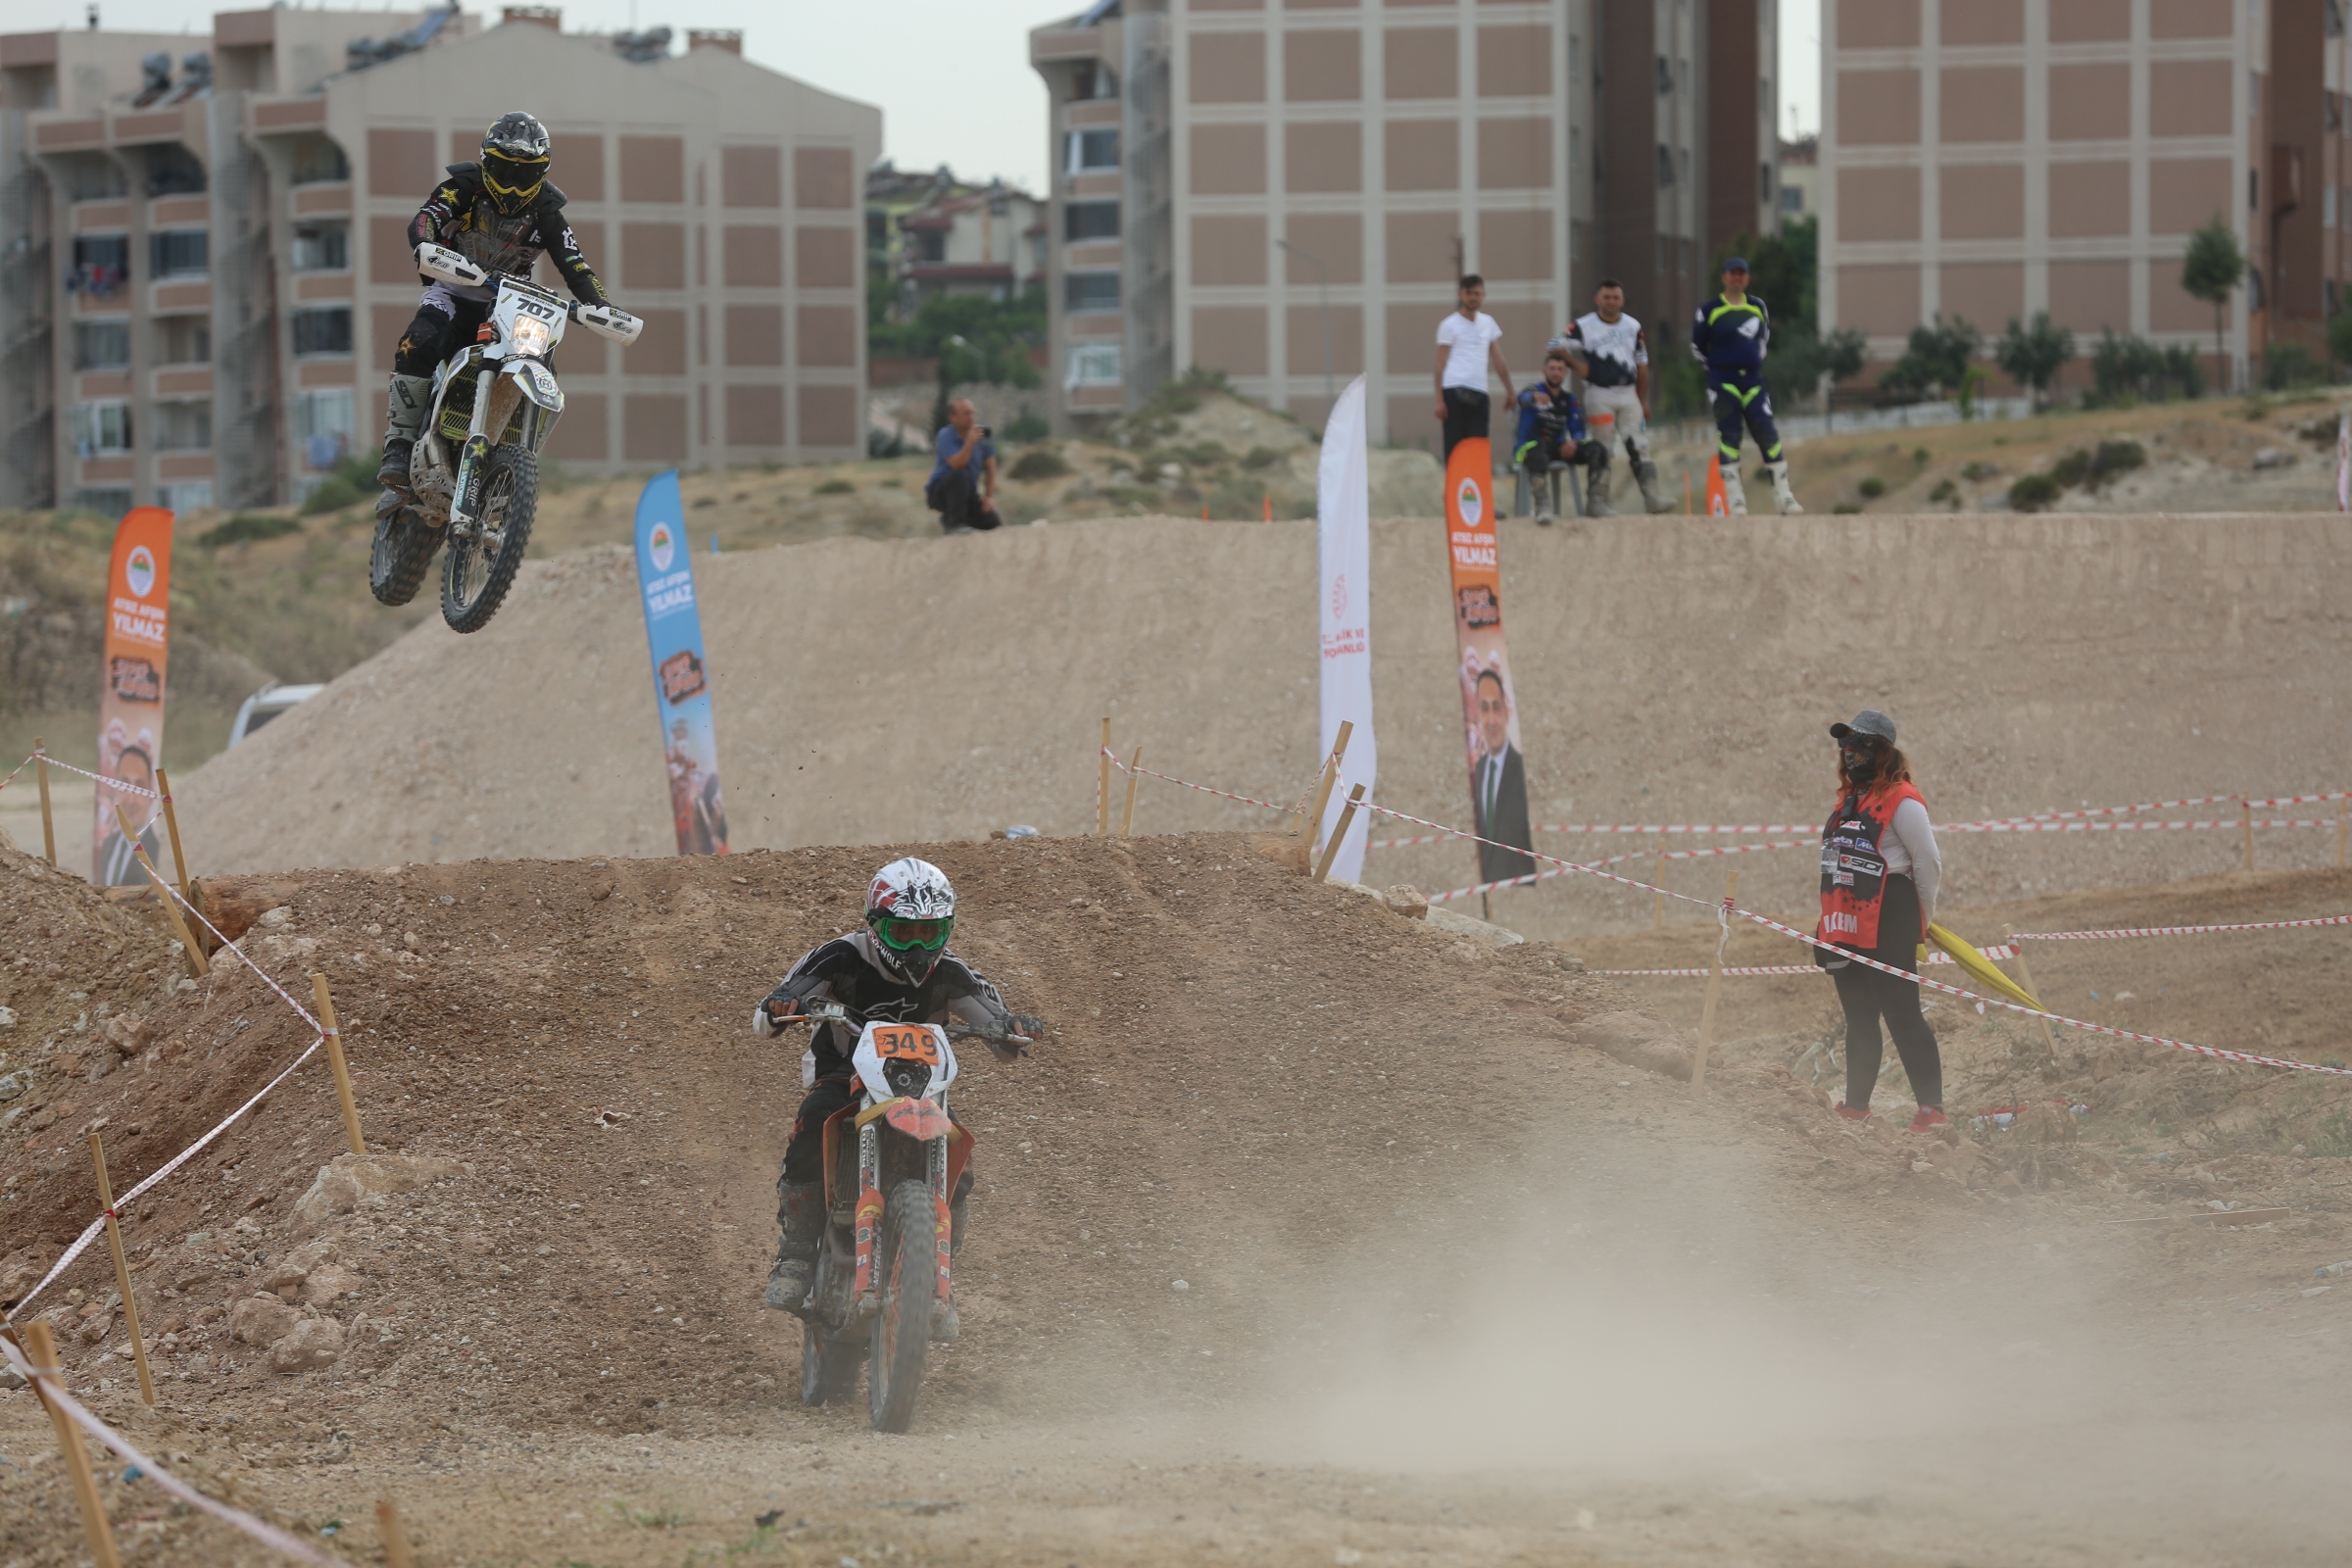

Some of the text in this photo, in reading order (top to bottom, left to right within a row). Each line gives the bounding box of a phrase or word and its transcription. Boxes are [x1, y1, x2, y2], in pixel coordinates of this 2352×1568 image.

[516, 297, 556, 319] 707
[1452, 545, 1496, 565] YILMAZ
[113, 611, 165, 642] YILMAZ
[883, 1032, 937, 1056] 349
[873, 1236, 882, 1285] METZELER
